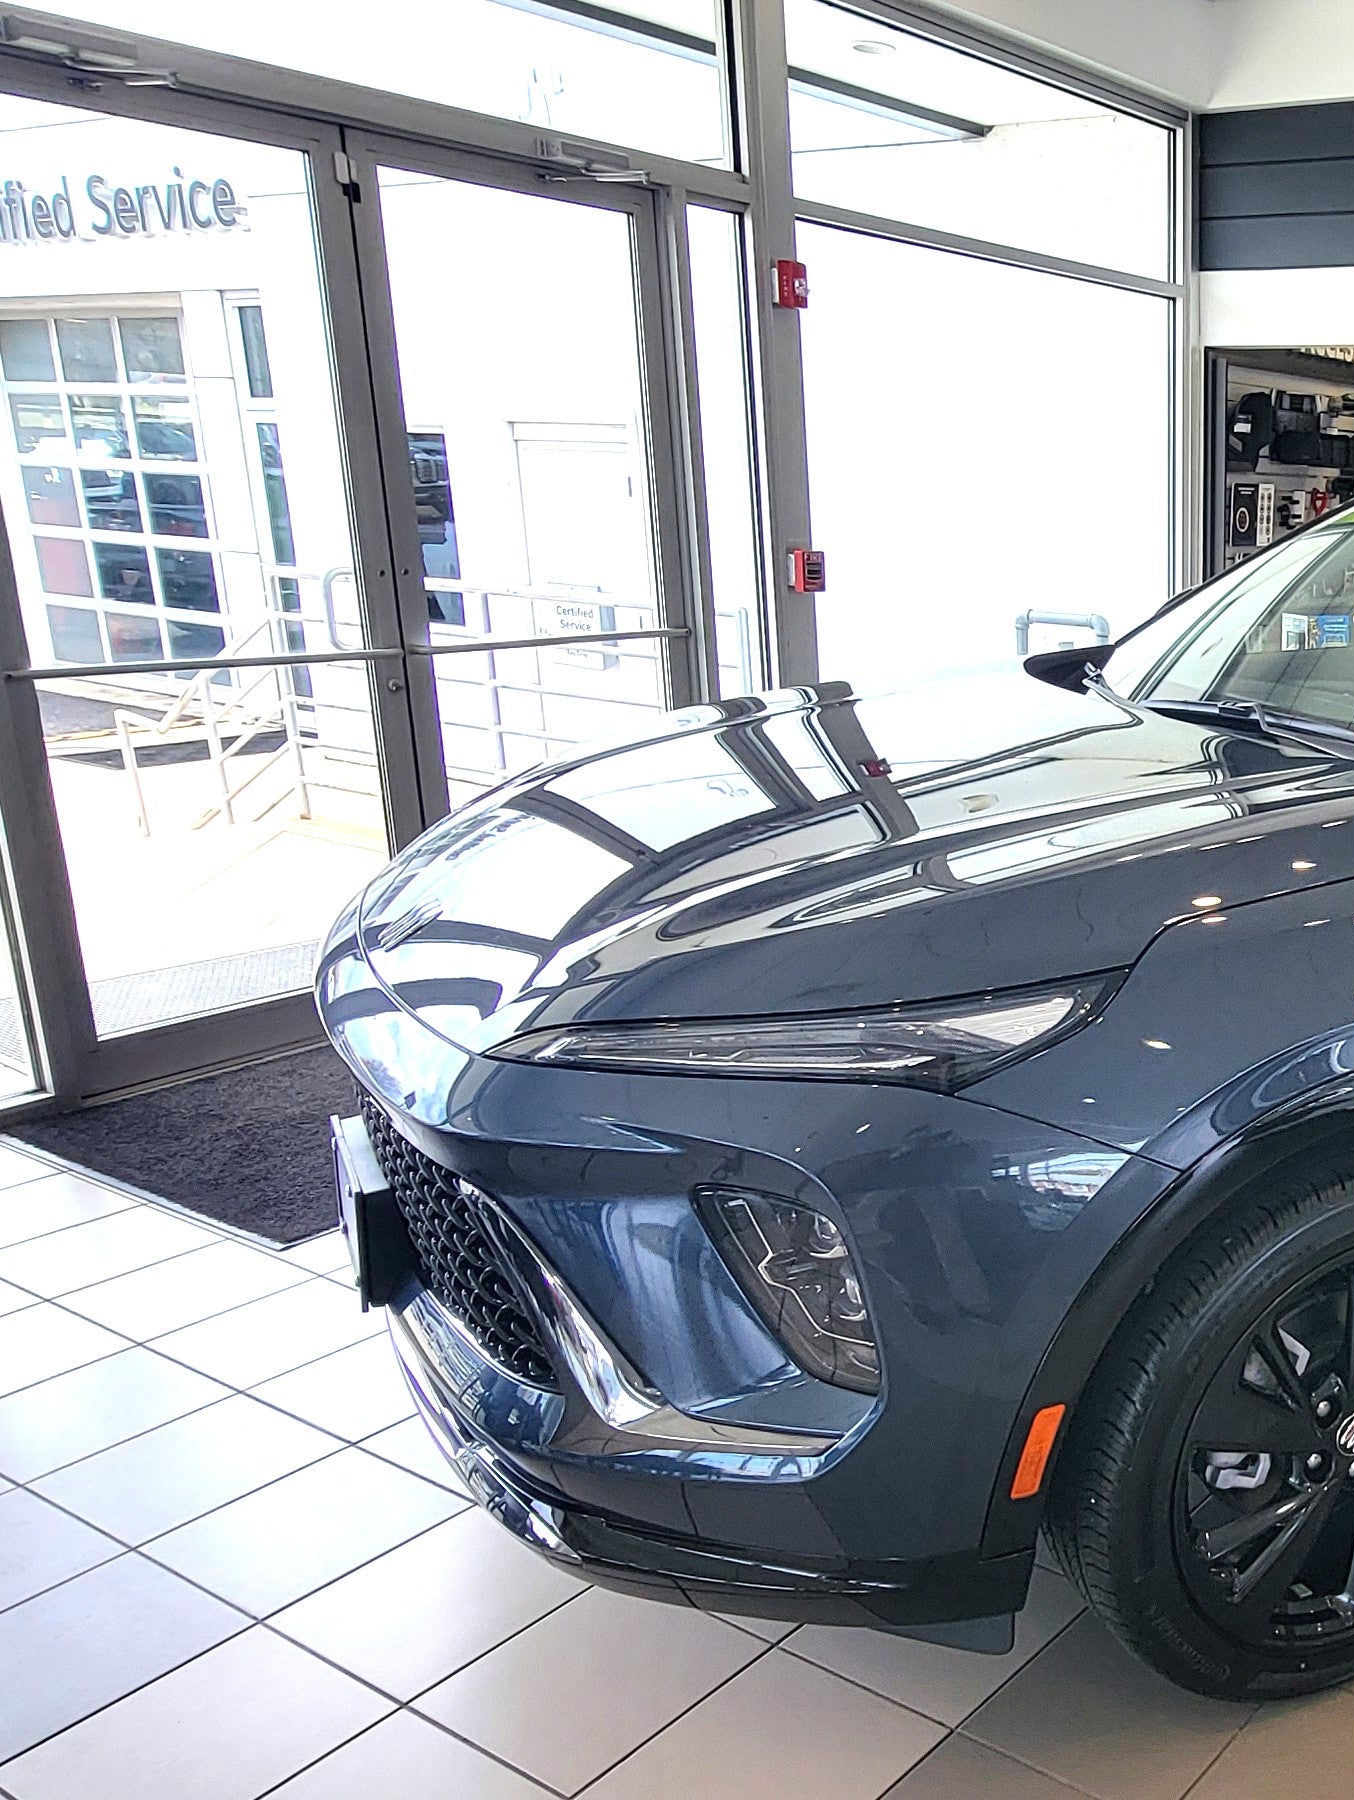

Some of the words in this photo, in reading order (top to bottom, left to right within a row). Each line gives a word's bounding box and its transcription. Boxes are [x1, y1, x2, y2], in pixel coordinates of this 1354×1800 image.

[87, 166, 238, 235] Service
[556, 605, 594, 618] Certified
[560, 619, 592, 631] Service
